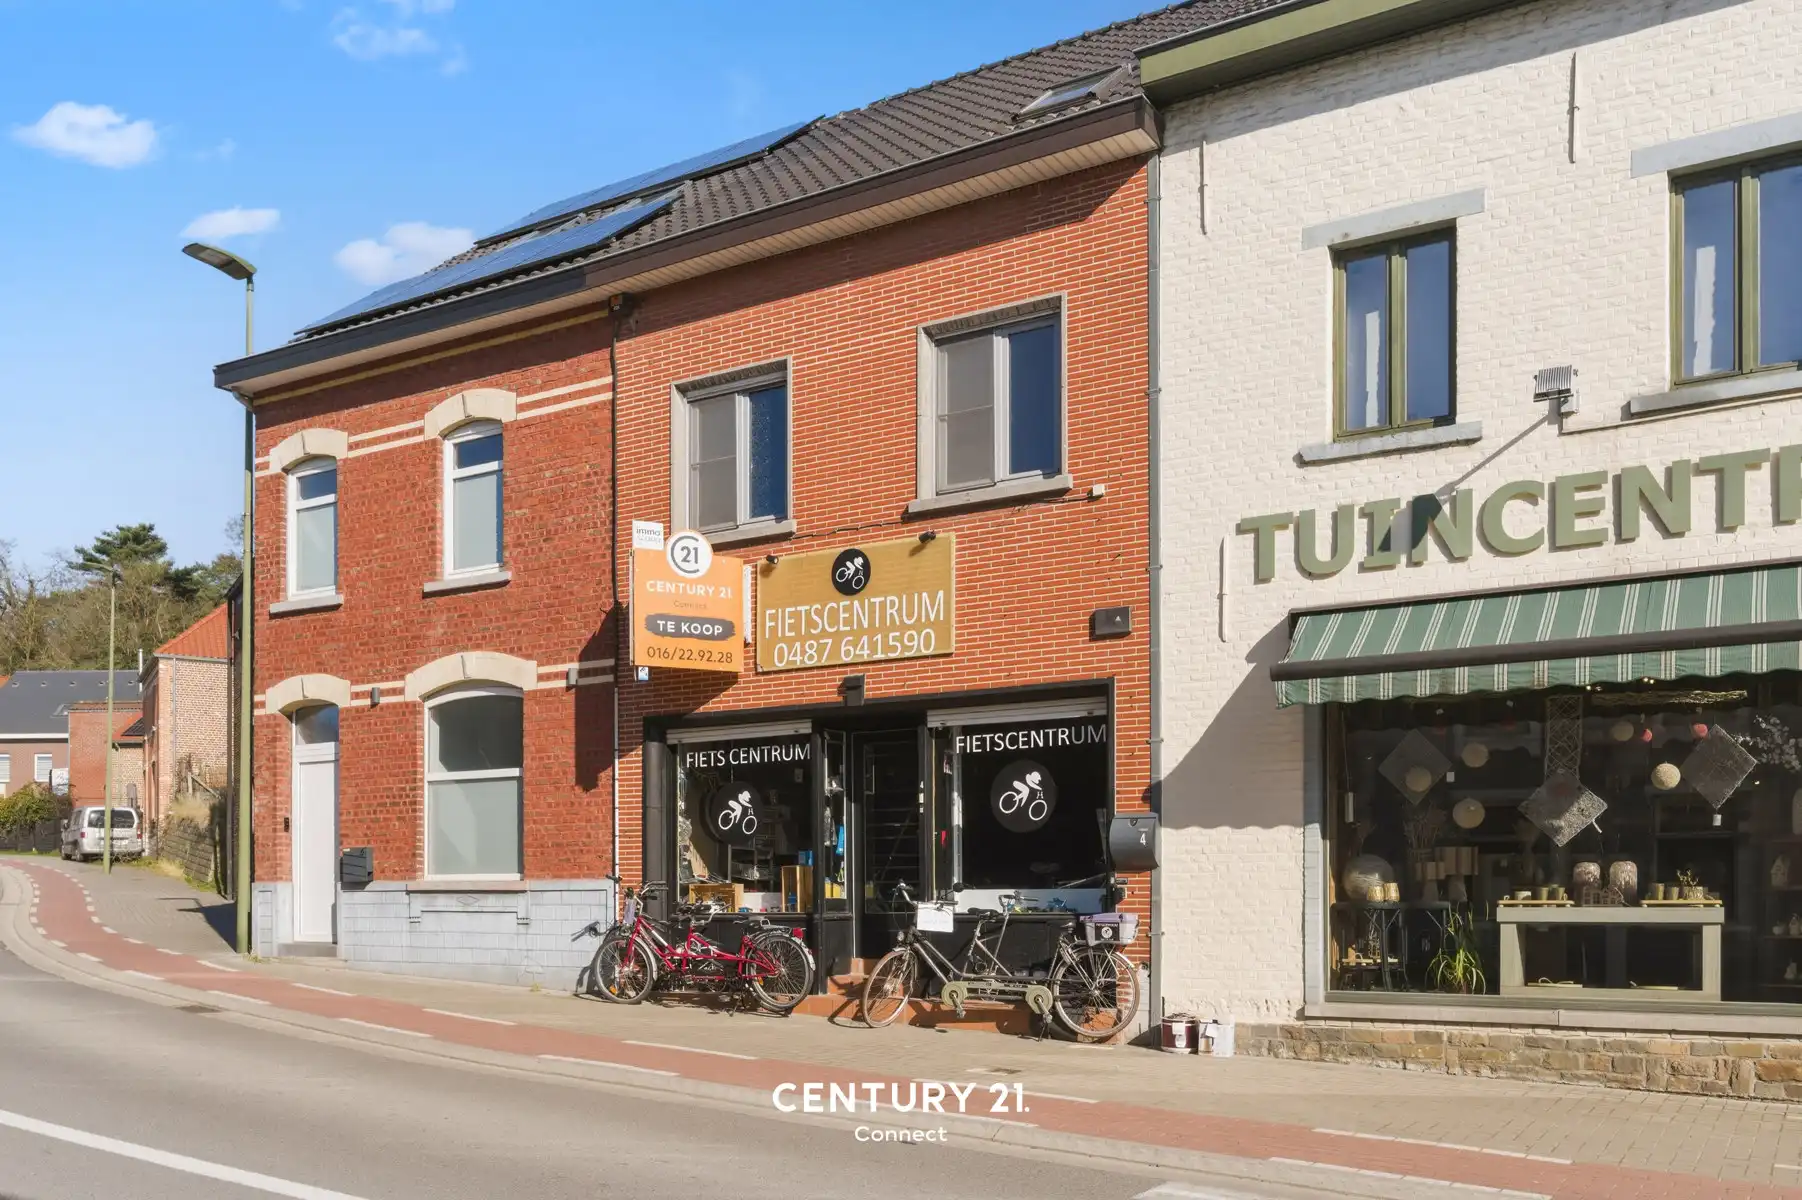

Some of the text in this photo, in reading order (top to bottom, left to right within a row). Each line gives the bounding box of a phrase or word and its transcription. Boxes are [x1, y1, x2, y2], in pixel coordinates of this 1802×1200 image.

[646, 580, 715, 597] CENTURY
[765, 589, 944, 639] FIETSCENTRUM
[657, 620, 723, 636] TE KOOP
[647, 646, 733, 664] 016/22.92.28
[774, 628, 936, 668] 0487 641590
[955, 723, 1107, 754] FIETSCENTRUM
[686, 743, 811, 768] FIETS CENTRUM
[1139, 832, 1147, 846] 4
